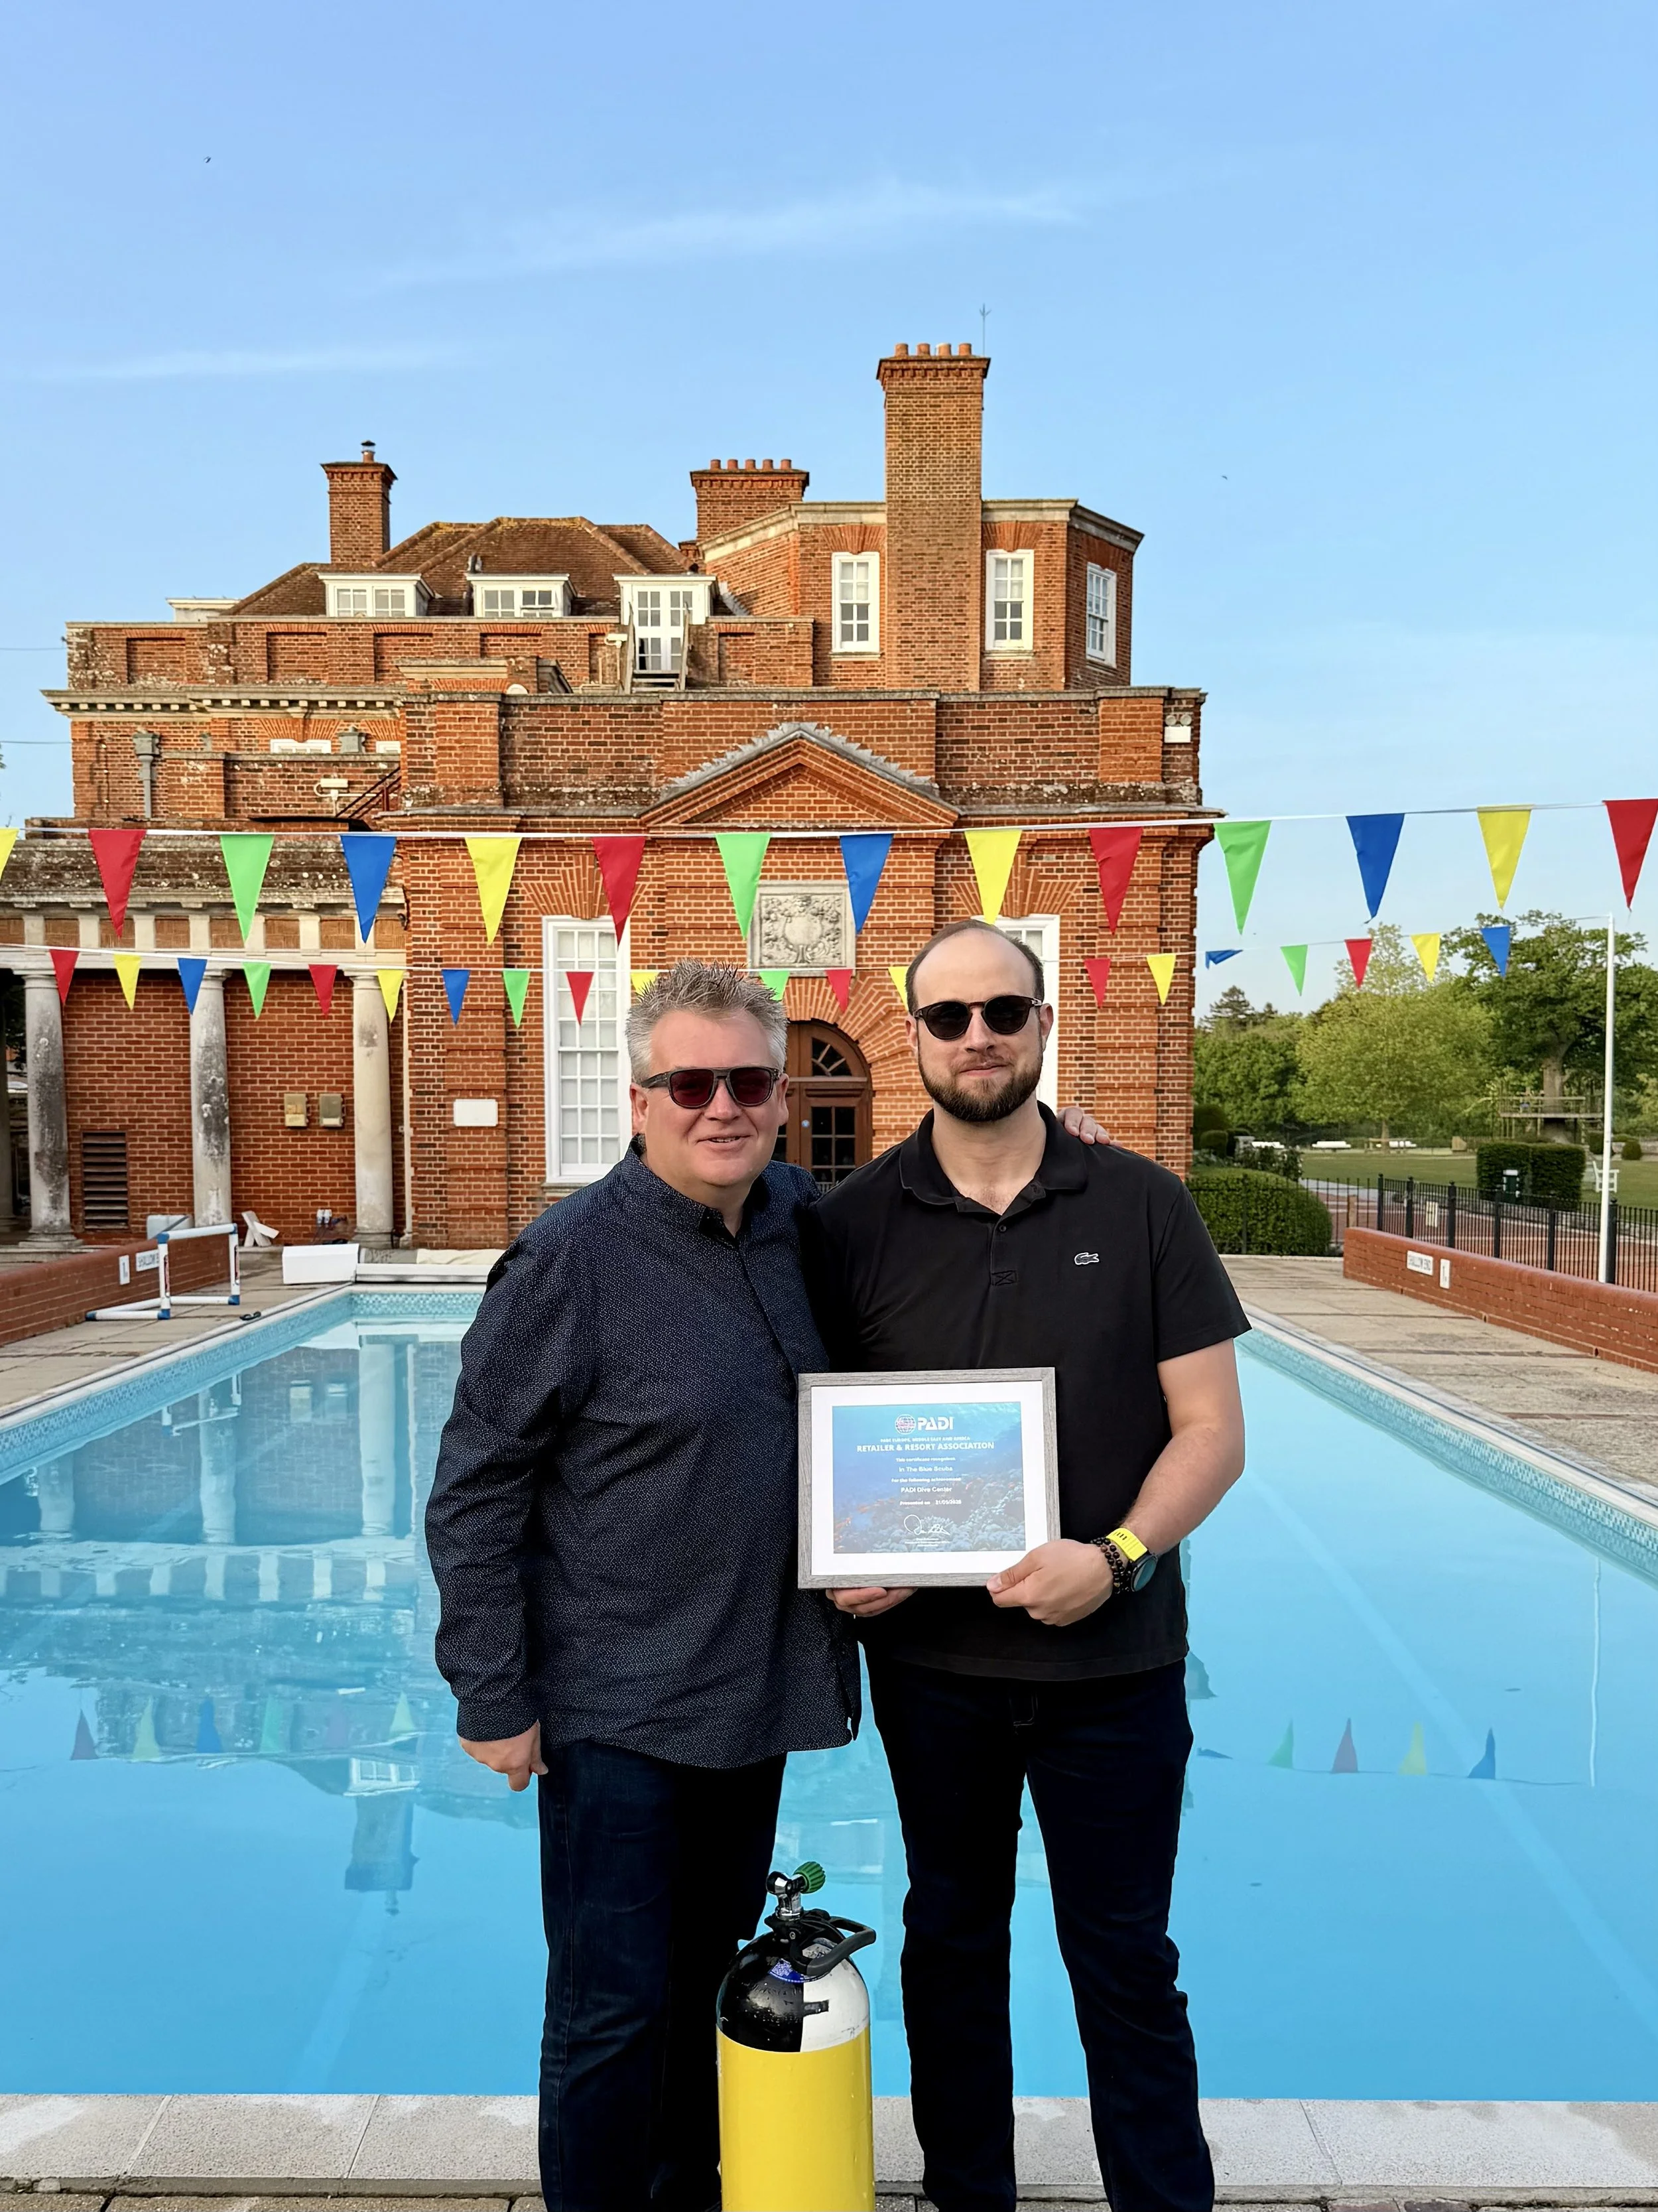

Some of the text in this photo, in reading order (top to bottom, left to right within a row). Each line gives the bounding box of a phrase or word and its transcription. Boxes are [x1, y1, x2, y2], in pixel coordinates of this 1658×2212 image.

[917, 1416, 955, 1431] PADI
[857, 1443, 895, 1452] RETAILER
[937, 1441, 994, 1450] ASSOCIATION
